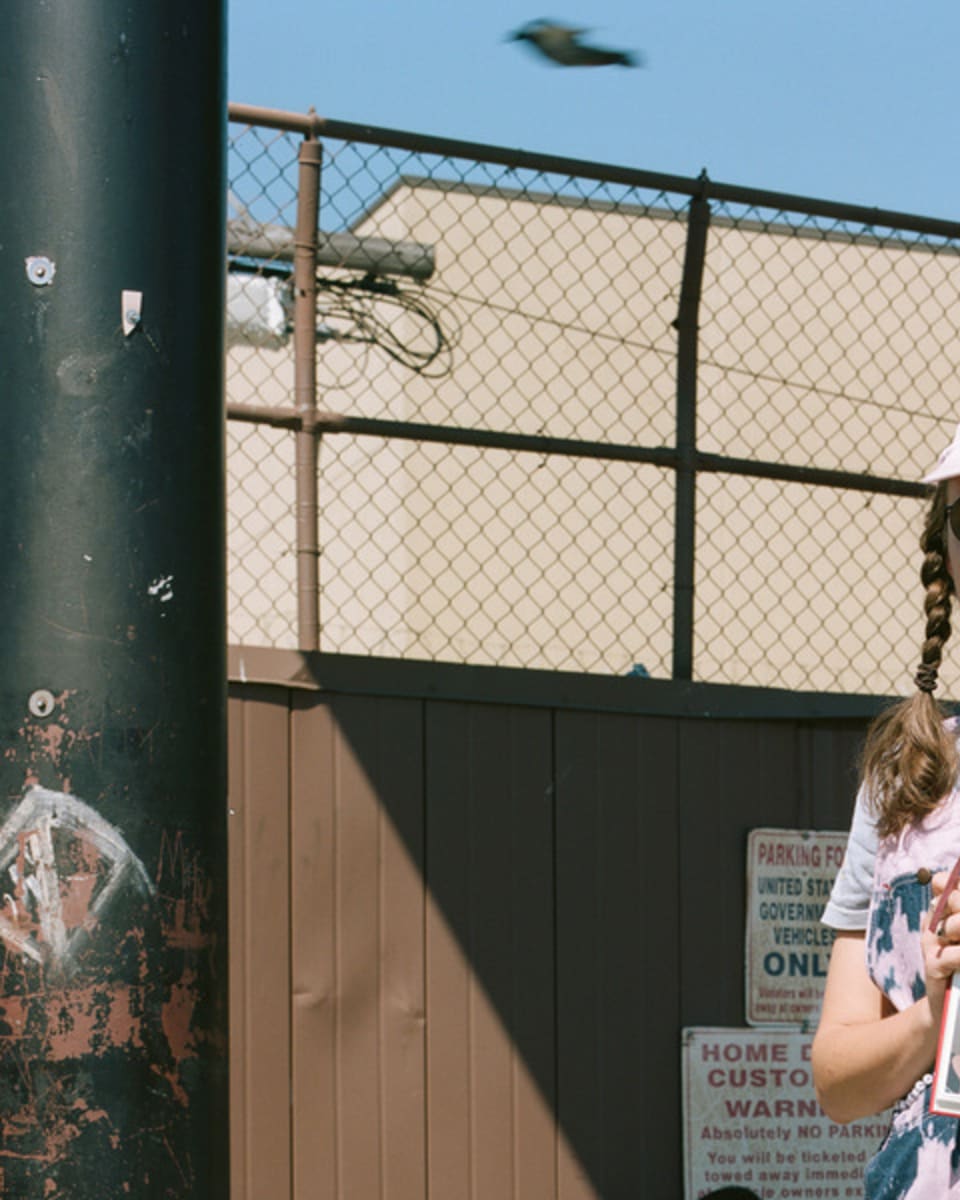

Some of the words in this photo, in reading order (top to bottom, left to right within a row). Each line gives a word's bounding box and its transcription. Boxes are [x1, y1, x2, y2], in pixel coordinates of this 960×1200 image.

[758, 843, 821, 867] PARKING
[826, 845, 847, 869] FO
[758, 877, 803, 896] UNITED
[763, 951, 831, 977] ONL
[703, 1044, 789, 1062] HOME
[708, 1069, 815, 1088] CUSTO
[702, 1125, 791, 1141] Absolutely
[797, 1125, 822, 1138] NO
[708, 1151, 736, 1164] You
[743, 1151, 771, 1164] will
[776, 1151, 796, 1164] be
[802, 1150, 867, 1164] ticketed
[705, 1169, 753, 1183] towed
[759, 1170, 799, 1183] away
[781, 1186, 840, 1198] owners
